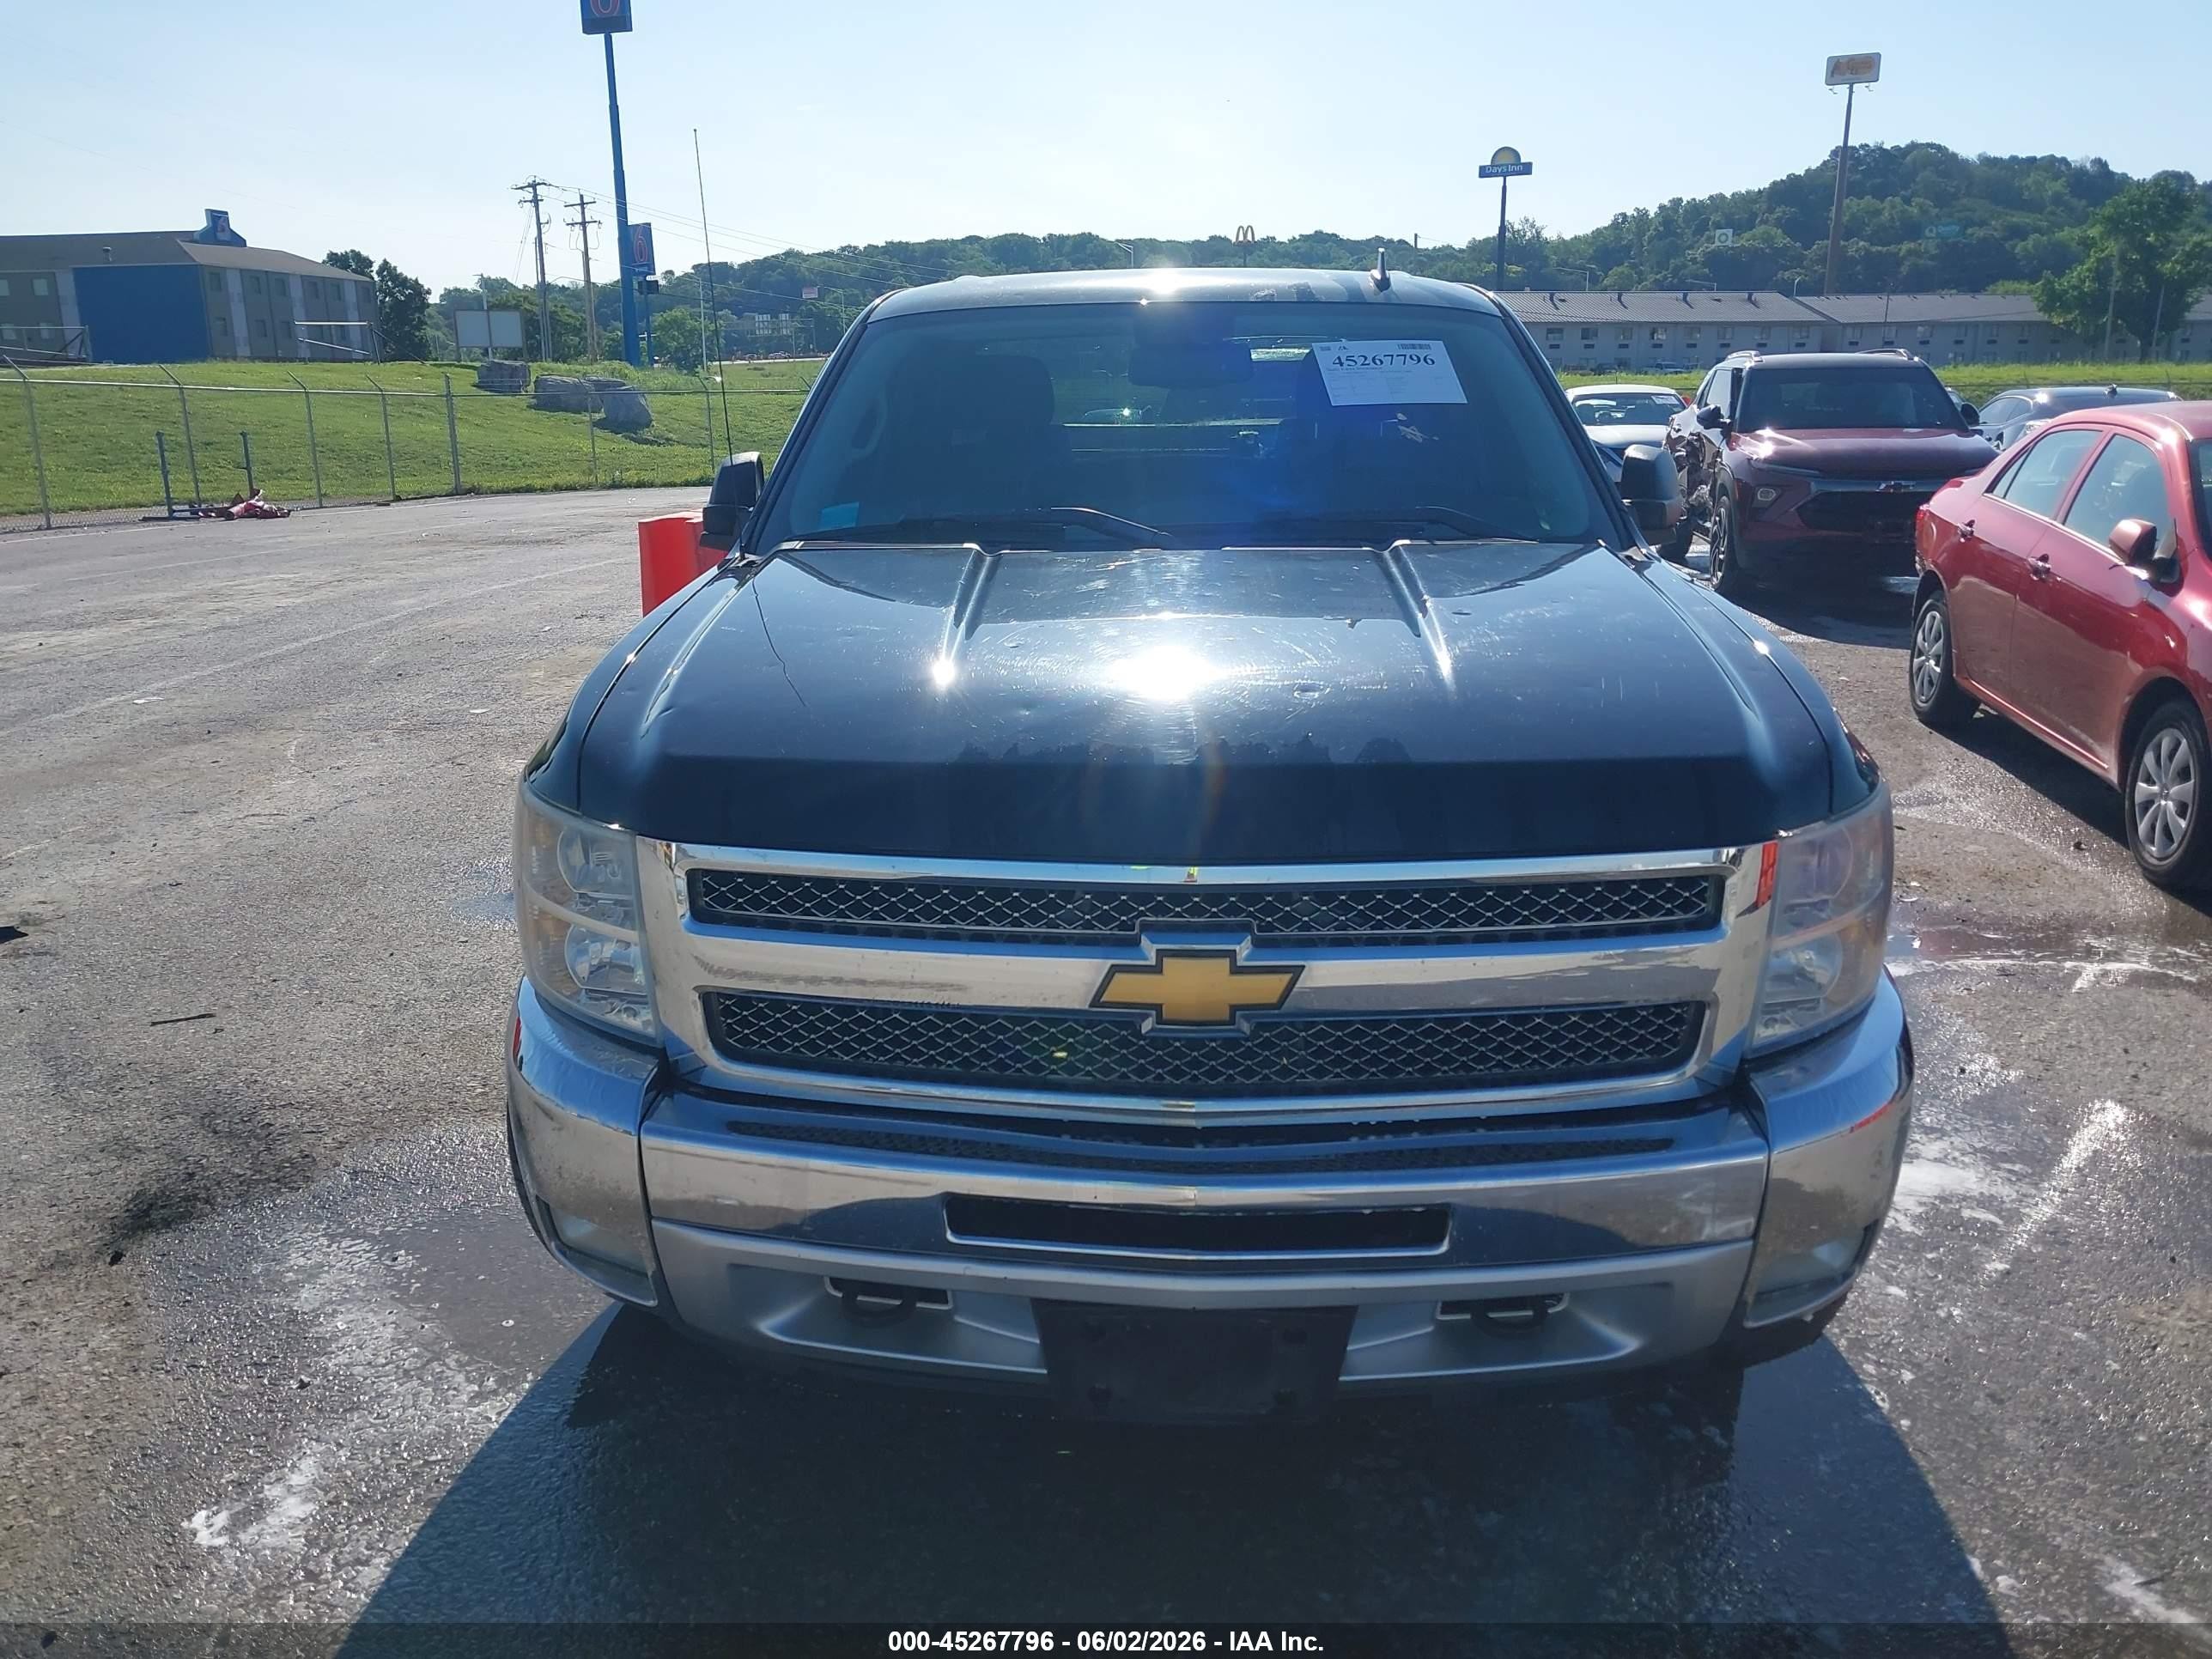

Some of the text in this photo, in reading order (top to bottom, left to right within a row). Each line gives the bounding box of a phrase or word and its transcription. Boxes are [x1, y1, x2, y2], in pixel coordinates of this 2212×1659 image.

[1486, 165, 1507, 173] Days
[634, 225, 648, 263] 6
[1332, 353, 1436, 368] 45267796
